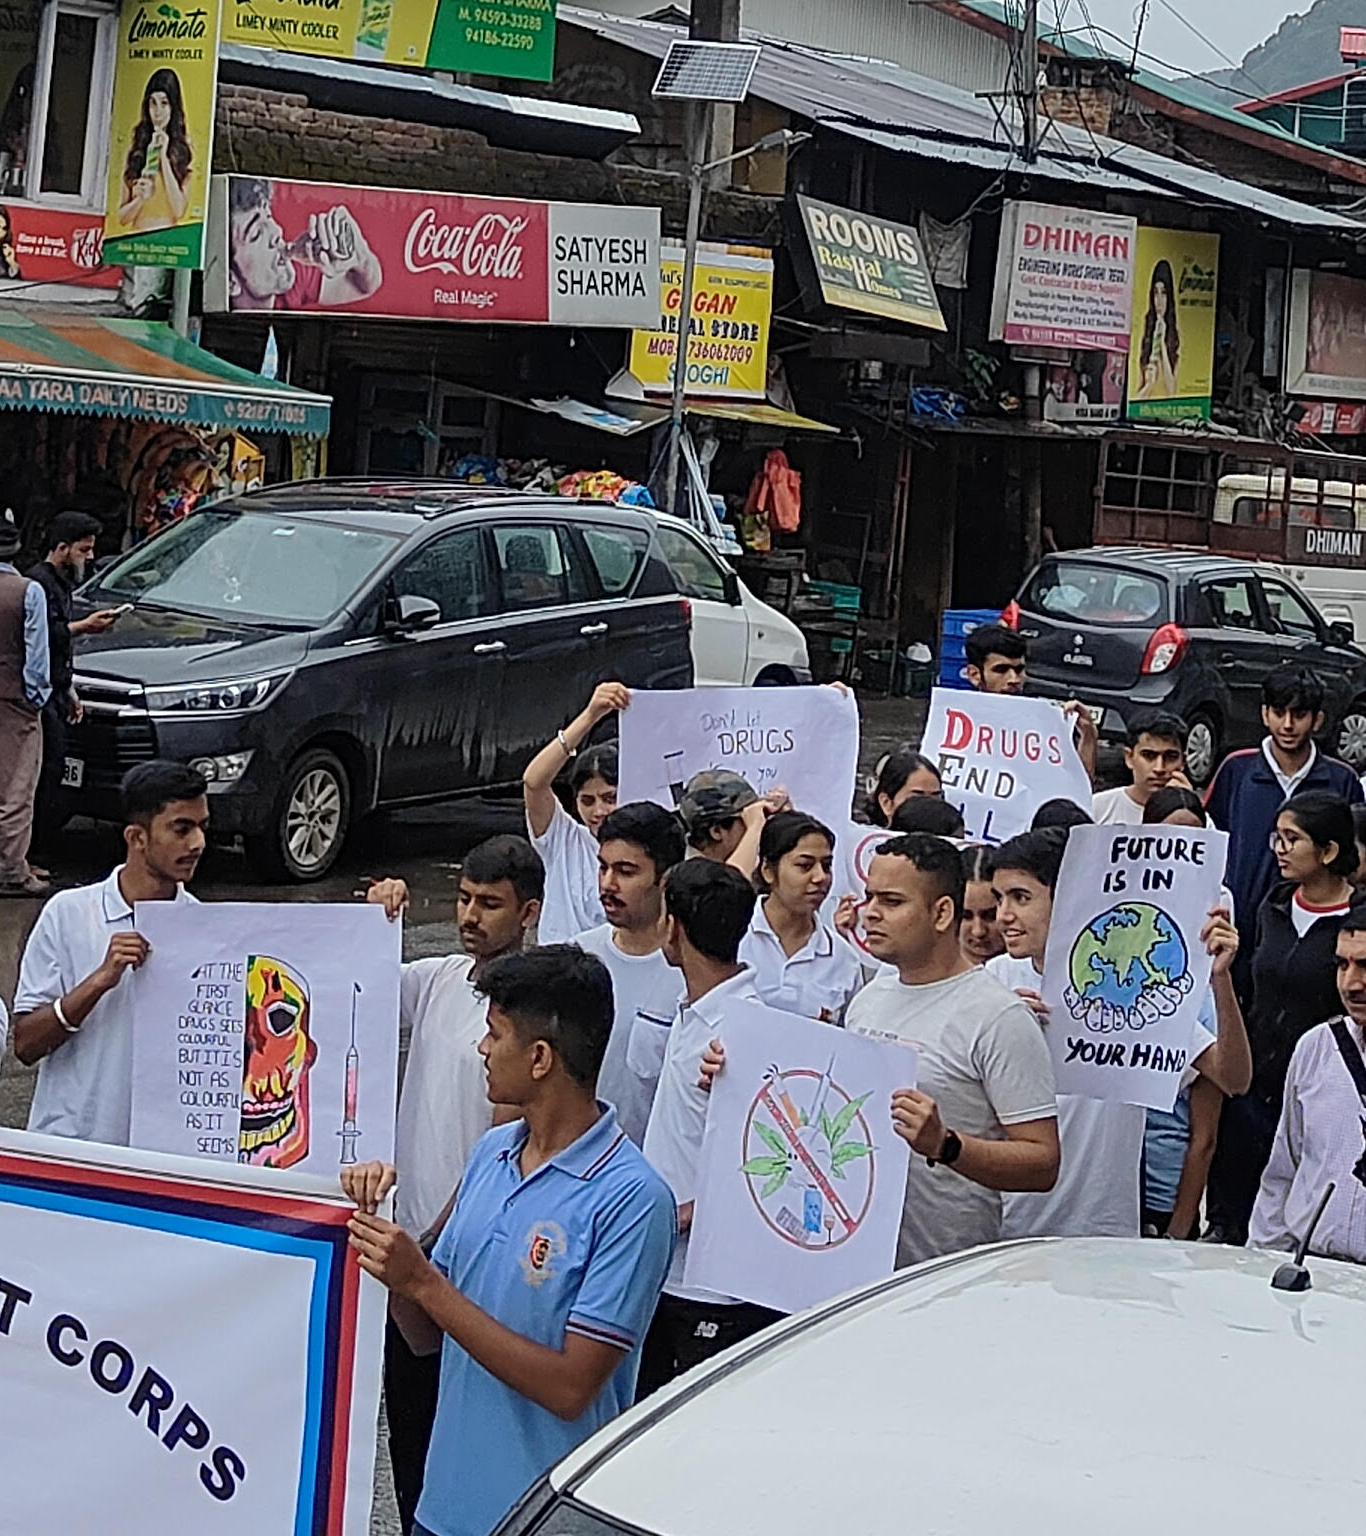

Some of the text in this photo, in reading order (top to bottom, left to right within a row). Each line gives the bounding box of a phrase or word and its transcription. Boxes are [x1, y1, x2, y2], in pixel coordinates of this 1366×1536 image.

[128, 7, 208, 44] Limonata
[236, 12, 340, 40] LIMEY MINTY COOLER
[404, 208, 530, 280] Coca-Cola
[807, 205, 919, 266] ROOMS
[1023, 223, 1130, 260] DHIMAN
[555, 236, 647, 265] SATYESH
[434, 288, 459, 304] Real
[557, 269, 646, 297] SHARMA
[666, 287, 738, 315] GGAN
[711, 319, 759, 342] STORE
[647, 337, 753, 364] MOB. 736062009
[666, 363, 730, 386] SOGHI
[29, 380, 75, 403] TARA
[79, 385, 132, 409] DAILY
[133, 390, 188, 415] NEEDS
[1305, 529, 1362, 556] DHIMAN
[717, 729, 795, 756] DRUGS
[940, 708, 1062, 764] DRUGS
[938, 752, 1015, 800] END
[1111, 836, 1206, 865] FUTURE
[1103, 868, 1174, 893] IS IN
[192, 963, 244, 982] AT THE
[196, 983, 232, 999] FIRST
[188, 1000, 234, 1017] GLANCE
[178, 1015, 216, 1031] DRUGS
[177, 1033, 232, 1047] COLOURFUL
[1065, 1037, 1127, 1066] YOUR
[178, 1048, 242, 1068] BUT IT IS
[178, 1070, 230, 1088] NOT AS
[186, 1113, 224, 1131] AS IT
[45, 1312, 247, 1502] CORPS
